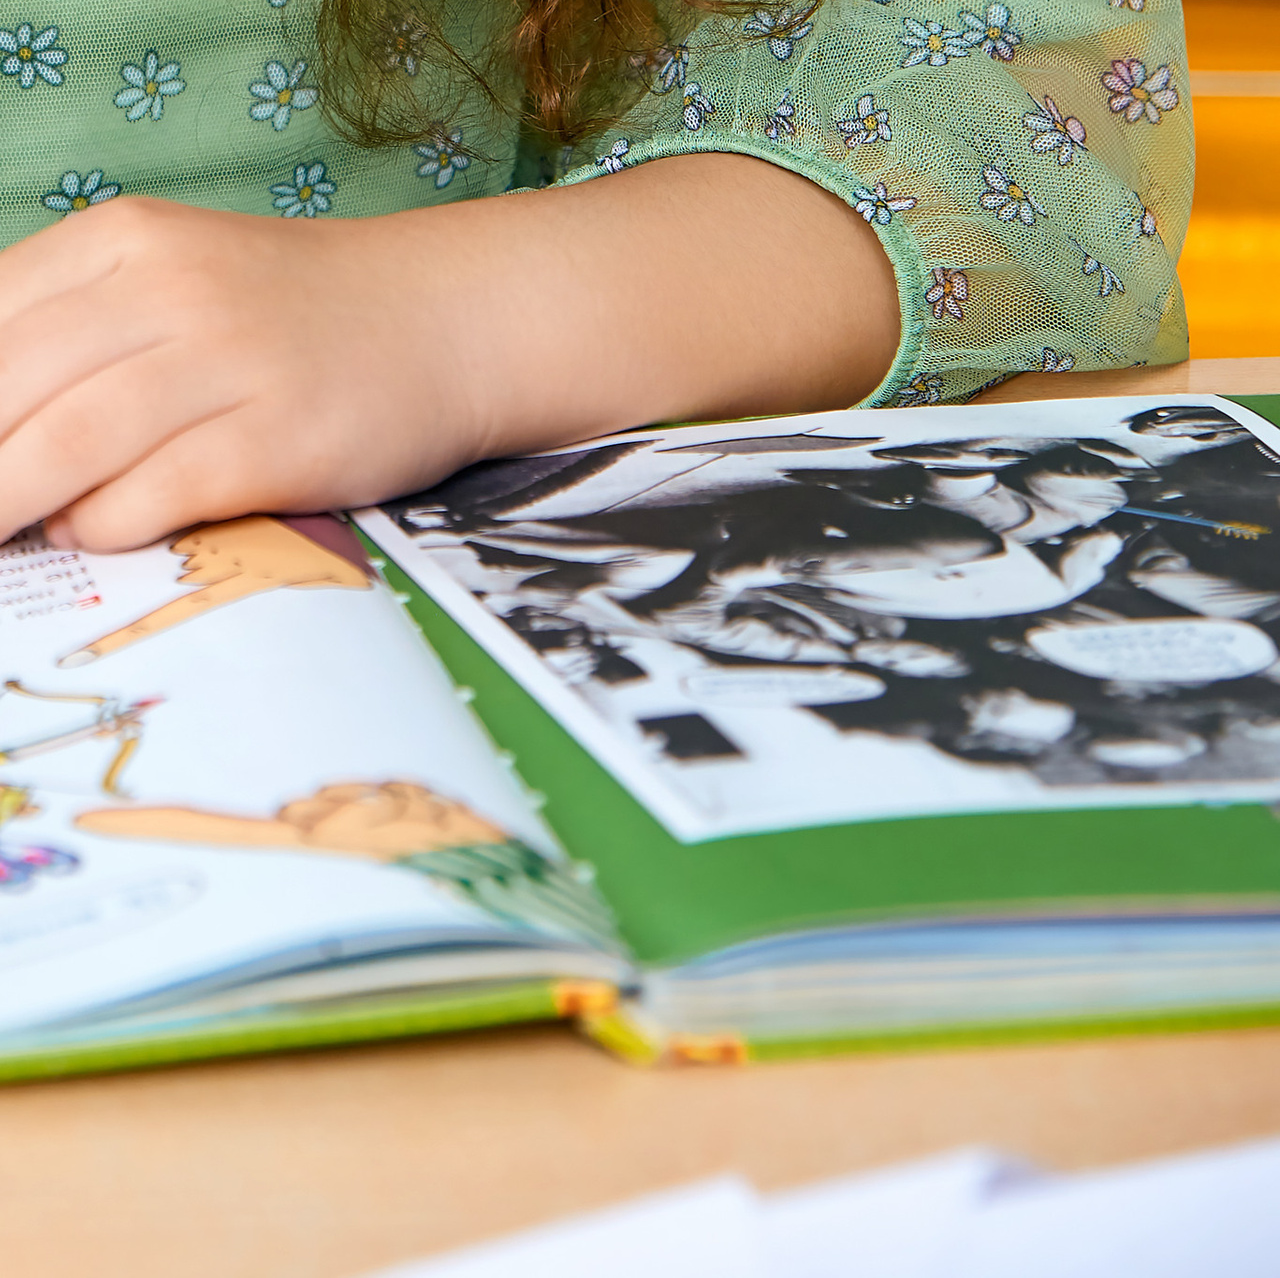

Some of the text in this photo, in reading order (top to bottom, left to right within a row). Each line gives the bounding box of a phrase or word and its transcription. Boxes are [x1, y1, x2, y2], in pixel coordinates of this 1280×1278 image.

[44, 567, 88, 584] Не
[71, 580, 96, 594] И
[15, 596, 103, 621] Если
